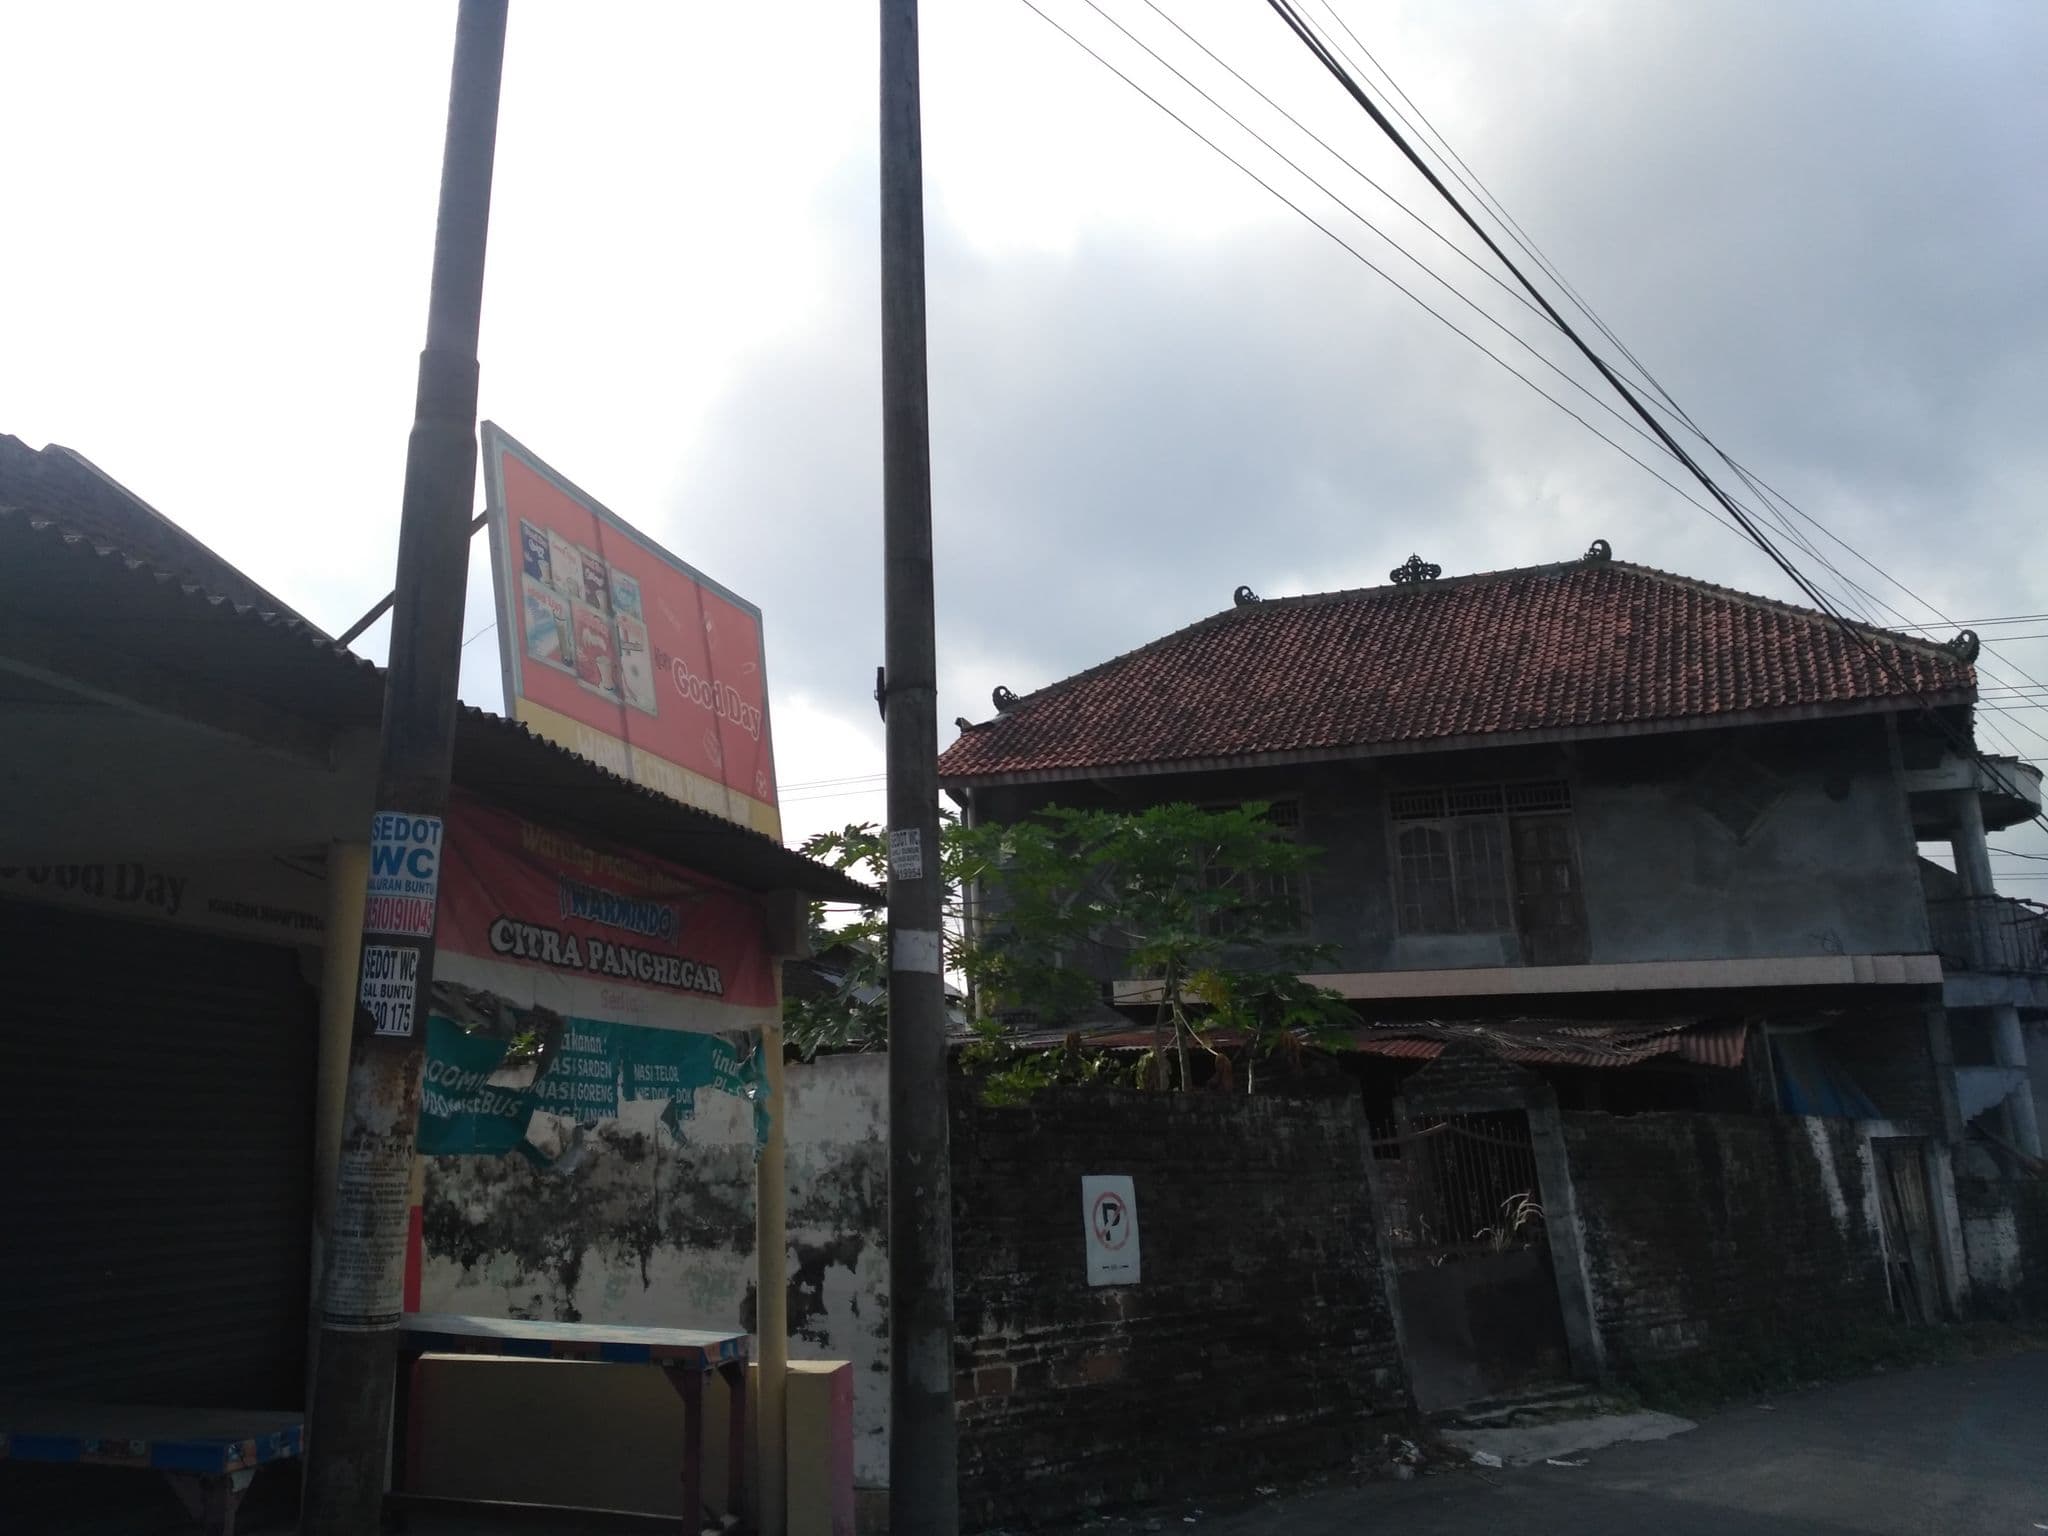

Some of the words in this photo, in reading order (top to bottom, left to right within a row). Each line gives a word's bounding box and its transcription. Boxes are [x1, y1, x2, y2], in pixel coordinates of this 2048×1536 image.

[672, 657, 726, 717] Good
[726, 686, 761, 741] Day
[372, 816, 440, 846] SEDOT
[372, 846, 435, 880] WC
[365, 949, 398, 979] SEDOT
[400, 951, 416, 982] WC
[489, 918, 583, 970] CITRA
[588, 938, 724, 995] PANGHEGAR
[363, 983, 377, 998] SAL
[380, 984, 413, 1000] BUNTU
[391, 1003, 411, 1031] 175
[577, 1058, 612, 1078] SARDEN
[577, 1083, 614, 1103] GORENG
